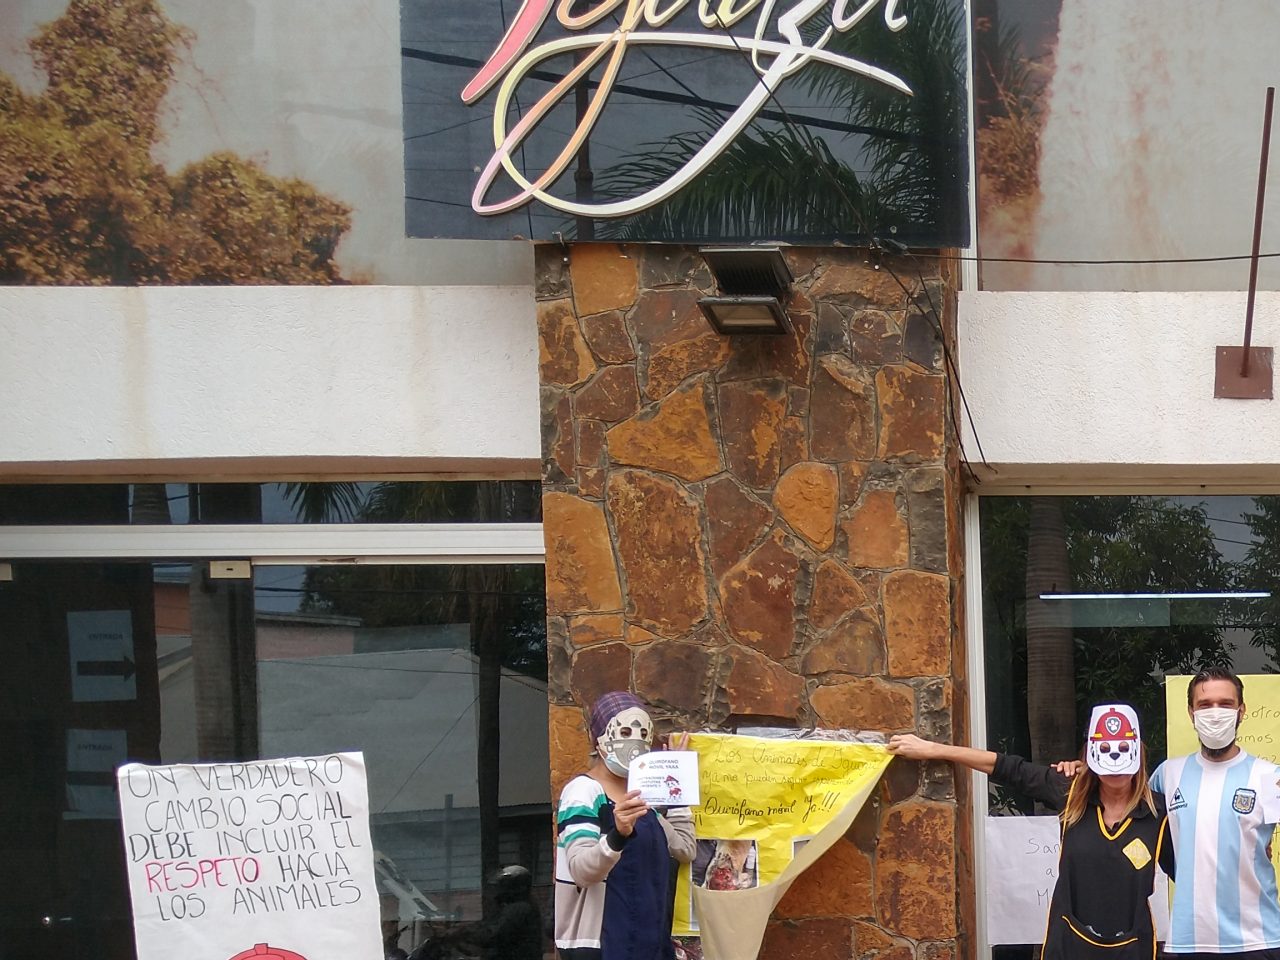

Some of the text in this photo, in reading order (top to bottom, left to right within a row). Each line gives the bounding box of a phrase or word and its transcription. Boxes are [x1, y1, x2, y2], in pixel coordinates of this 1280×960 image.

[127, 755, 343, 798] UN VERDADERO
[145, 790, 352, 833] CAMBIO SOCIAL
[128, 821, 361, 862] DEBE INCLUIR EL
[145, 851, 351, 893] RESPETO HACIA
[156, 879, 361, 921] LOS ANIMALES
